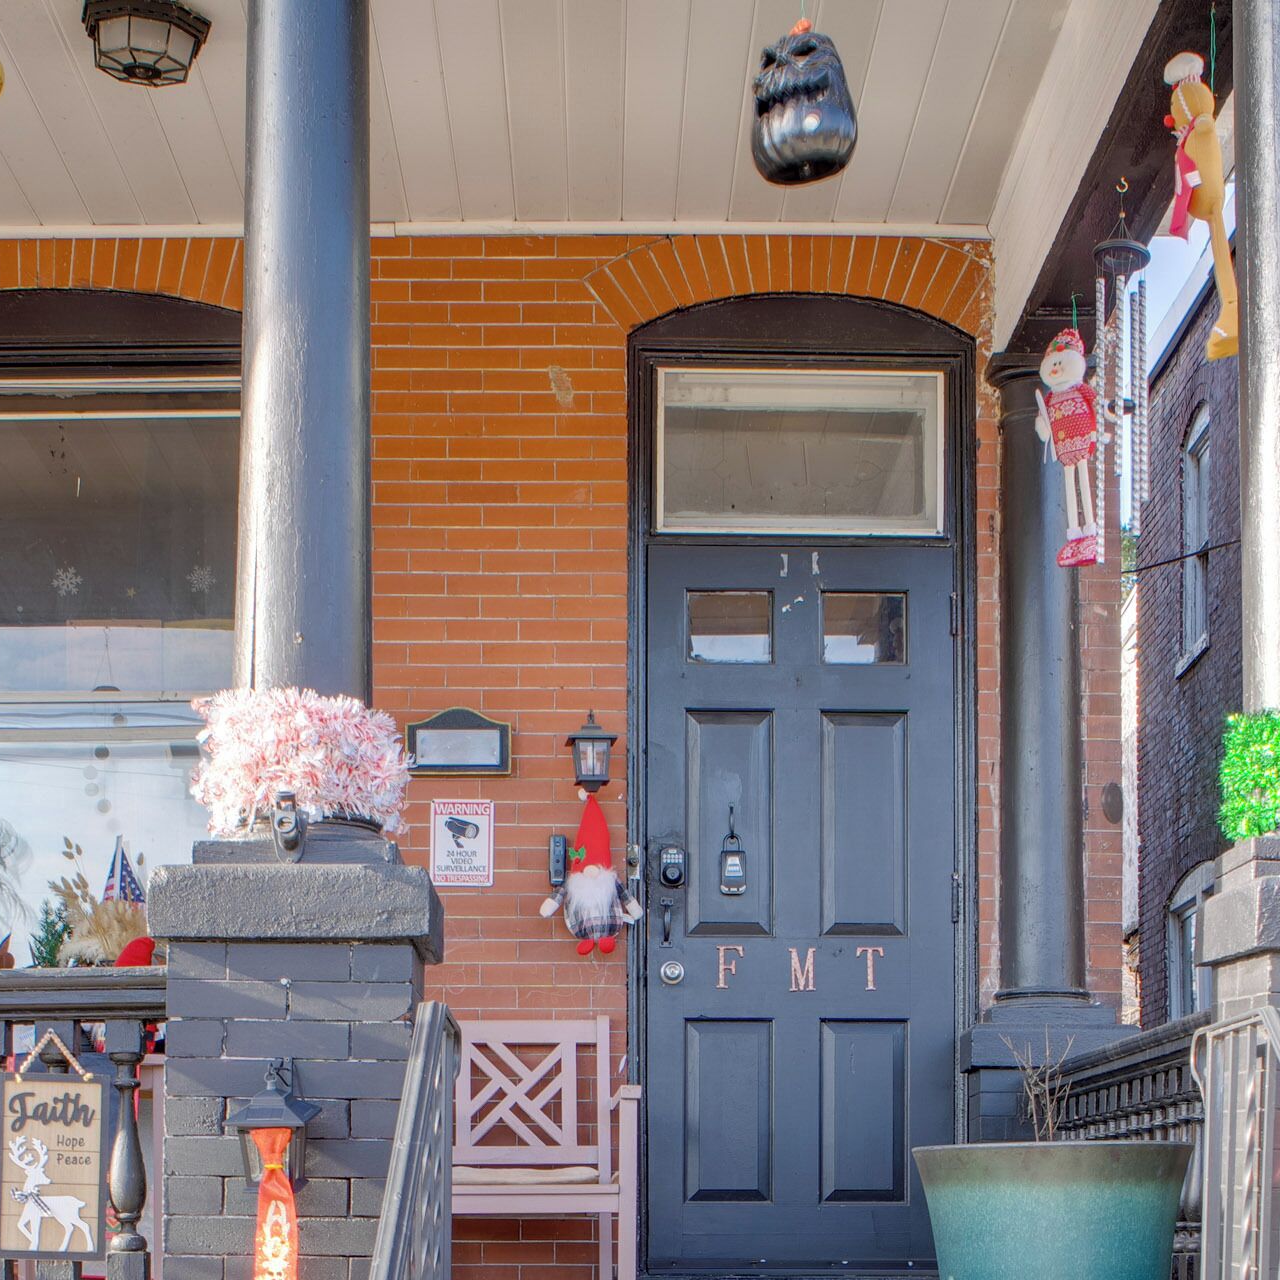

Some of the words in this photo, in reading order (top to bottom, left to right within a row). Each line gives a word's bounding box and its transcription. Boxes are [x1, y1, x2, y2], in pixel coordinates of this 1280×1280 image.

[435, 803, 490, 815] WARNING
[446, 850, 455, 858] 24
[456, 850, 477, 858] HOUR
[436, 865, 487, 873] SURVEILLANCE
[8, 1091, 96, 1133] Faith
[56, 1134, 86, 1151] Hope
[56, 1153, 92, 1166] Peace
